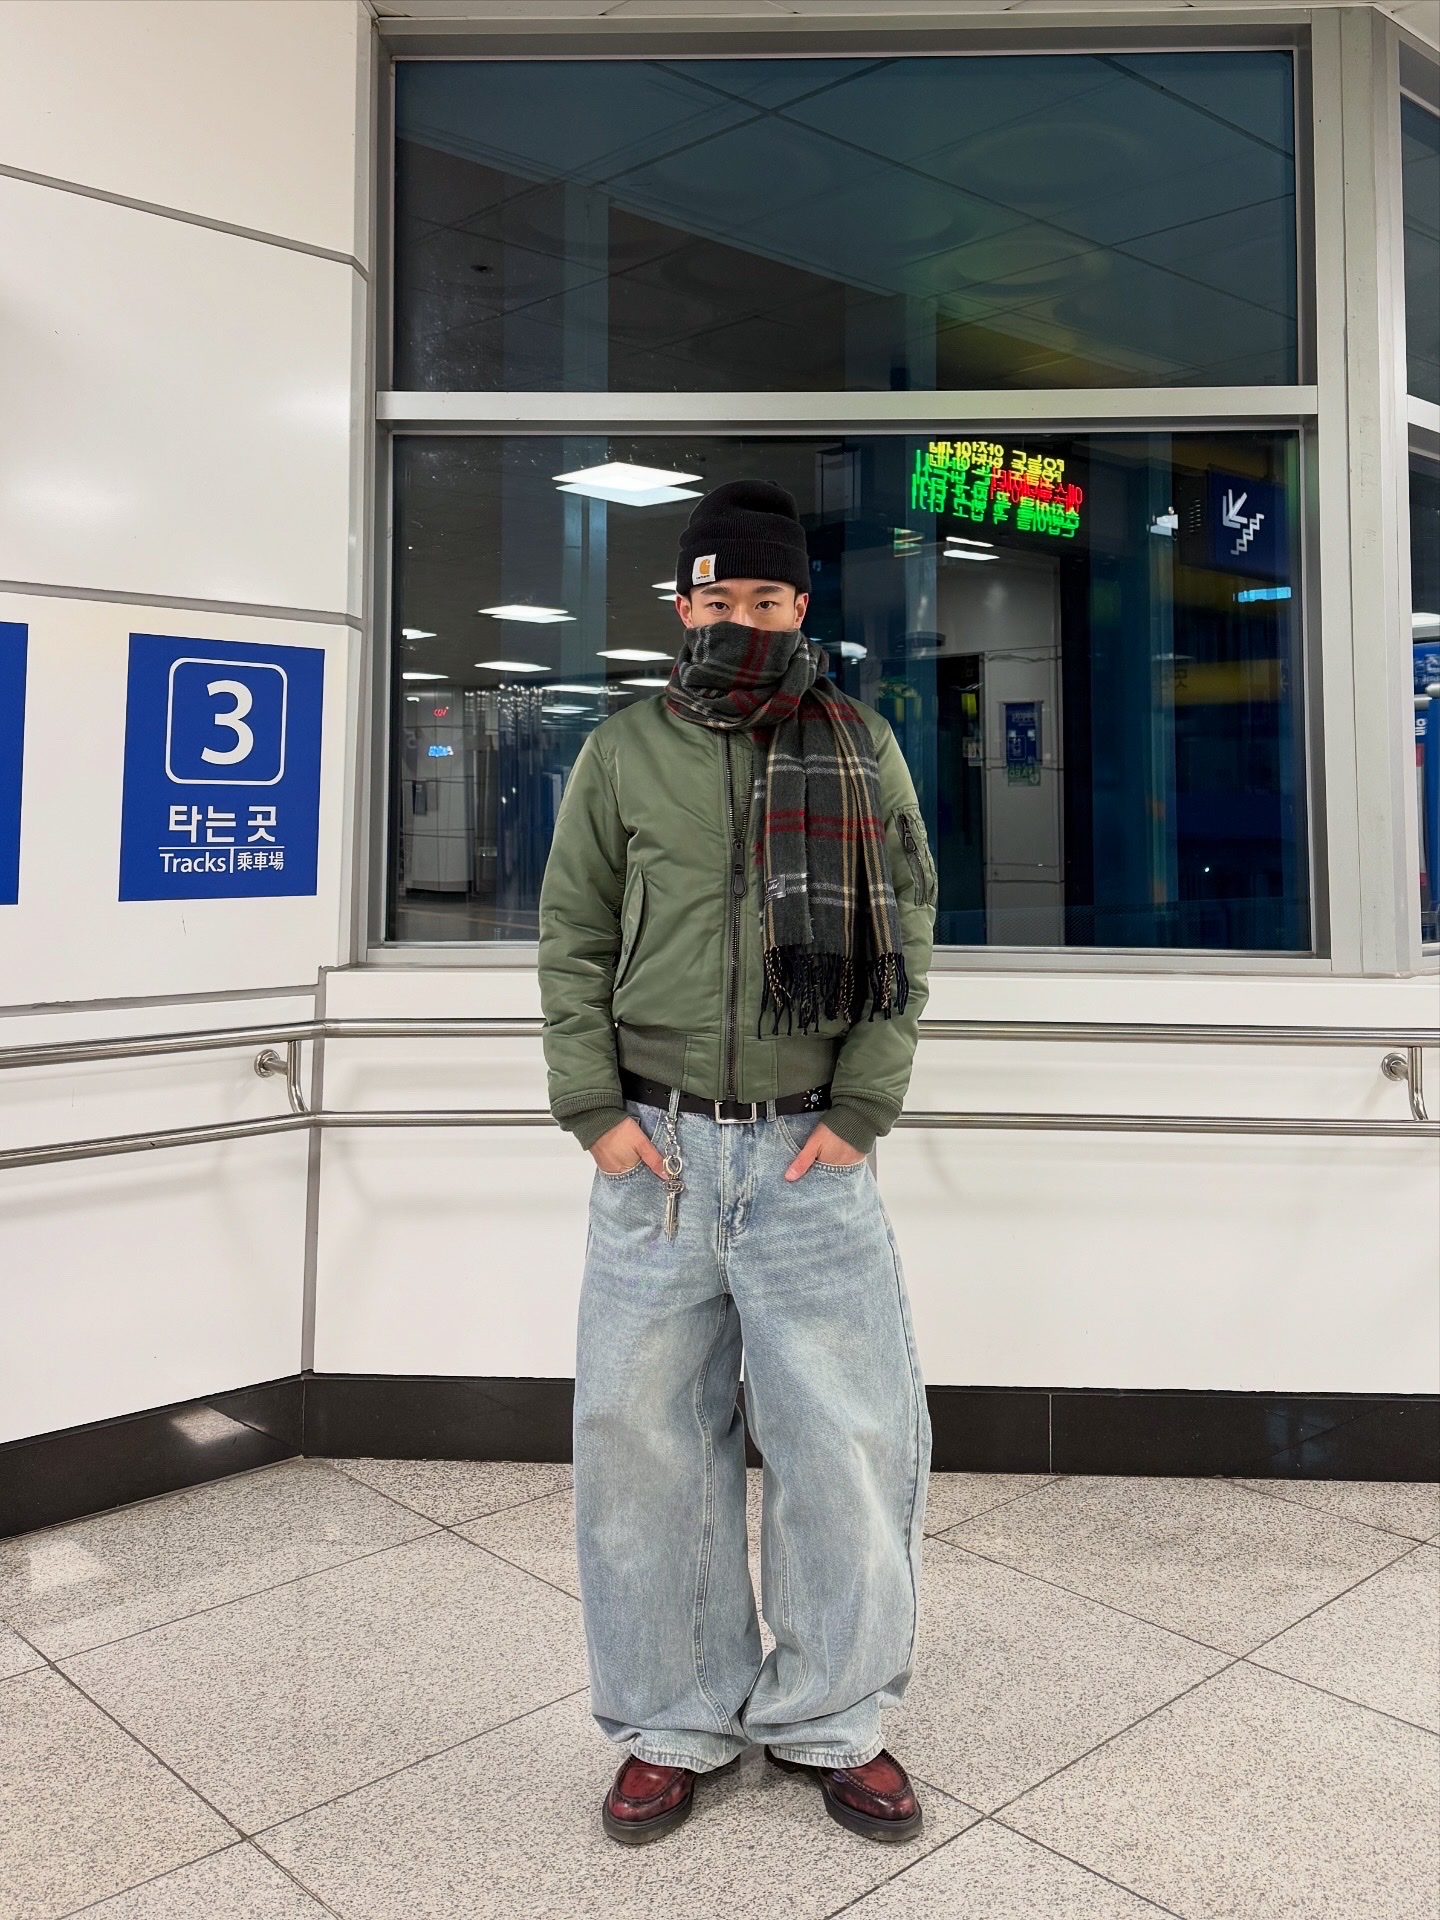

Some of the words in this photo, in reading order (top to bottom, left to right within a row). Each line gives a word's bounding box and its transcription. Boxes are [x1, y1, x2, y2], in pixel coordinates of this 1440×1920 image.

[201, 680, 253, 764] 3
[169, 806, 236, 843] 타는
[248, 806, 276, 842] 곳
[160, 852, 226, 872] Tracks
